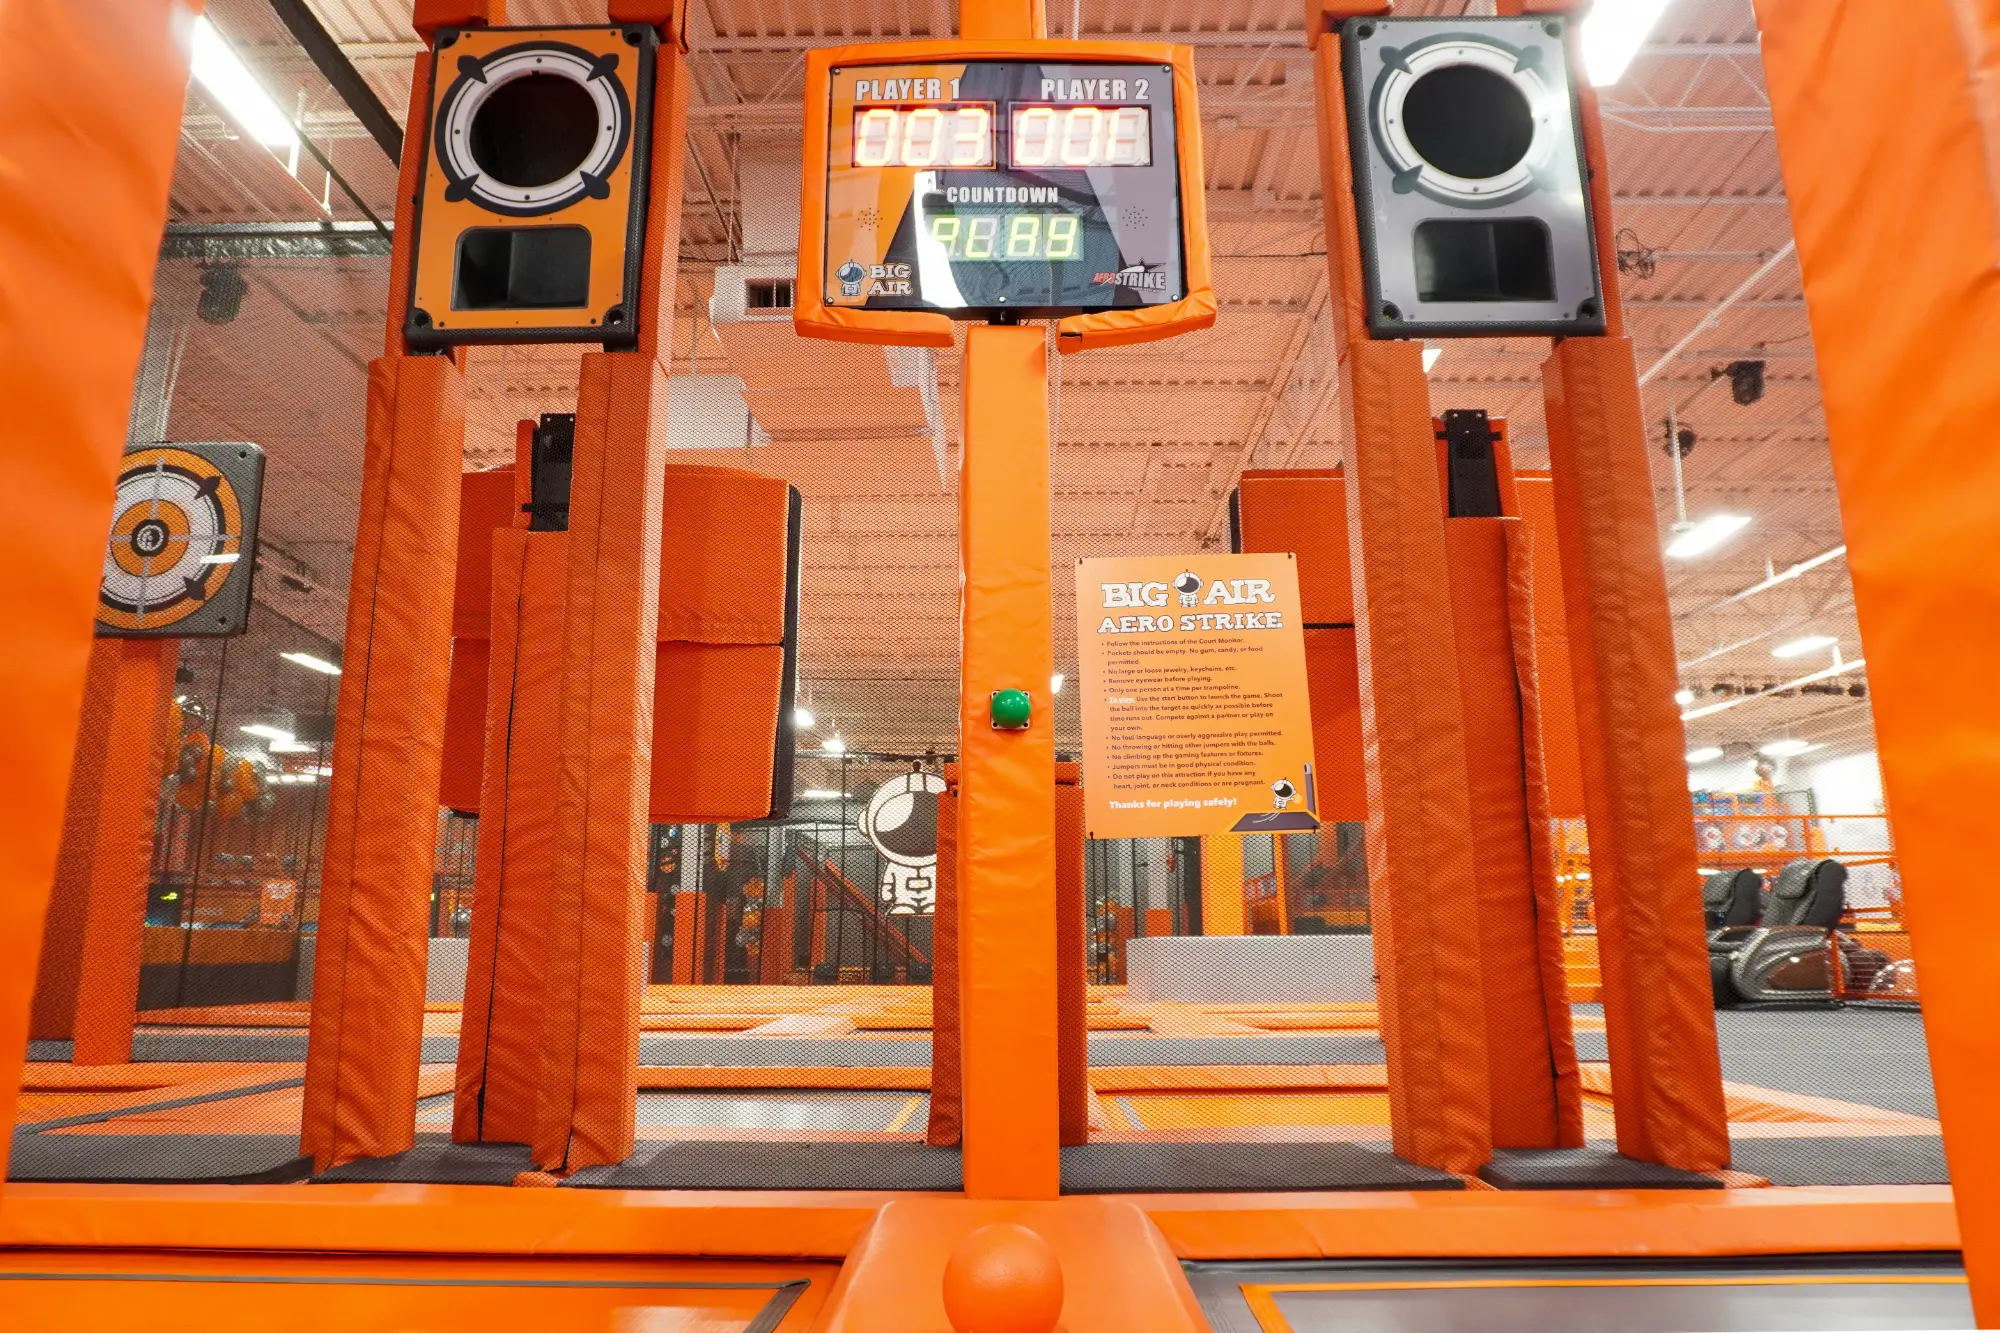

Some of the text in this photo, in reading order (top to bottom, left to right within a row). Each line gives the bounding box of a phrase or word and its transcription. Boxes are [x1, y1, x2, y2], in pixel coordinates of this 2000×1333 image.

[856, 77, 960, 101] PLAYER 1
[1041, 78, 1149, 100] PLAYER 2
[856, 108, 989, 166] 003
[946, 186, 1059, 203] COUNTDOWN
[869, 263, 912, 279] BIG
[867, 280, 914, 296] AIR
[1100, 578, 1276, 608] BIG AIR
[1097, 612, 1284, 634] AERO STRIKE
[1166, 648, 1188, 656] empty.
[1119, 667, 1135, 676] large
[1136, 677, 1162, 685] eyewear
[1188, 674, 1212, 683] playing.
[1109, 686, 1124, 695] Only
[1140, 686, 1161, 694] person
[1204, 682, 1240, 692] trampoline.
[1161, 704, 1180, 712] target
[1191, 703, 1213, 711] quickly
[1224, 701, 1250, 710] possible
[1156, 713, 1184, 722] Compete
[1187, 712, 1209, 721] against
[1217, 712, 1240, 720] partner
[1250, 710, 1263, 719] play
[1111, 725, 1125, 733] your
[1137, 732, 1166, 741] language
[1176, 732, 1196, 740] overly
[1198, 730, 1232, 740] aggressive
[1234, 730, 1247, 739] play
[1123, 743, 1152, 752] throwing
[1162, 742, 1183, 750] hitting
[1203, 740, 1230, 749] jumpers
[1123, 752, 1151, 761] climbing
[1175, 751, 1199, 760] gaming
[1112, 762, 1140, 771] Jumpers
[1177, 760, 1193, 769] good
[1196, 760, 1221, 768] physical
[1137, 772, 1150, 780] play
[1114, 782, 1132, 790] heart,
[1234, 779, 1265, 787] pregnant.
[1109, 798, 1236, 809] Thanks for playing safely!
